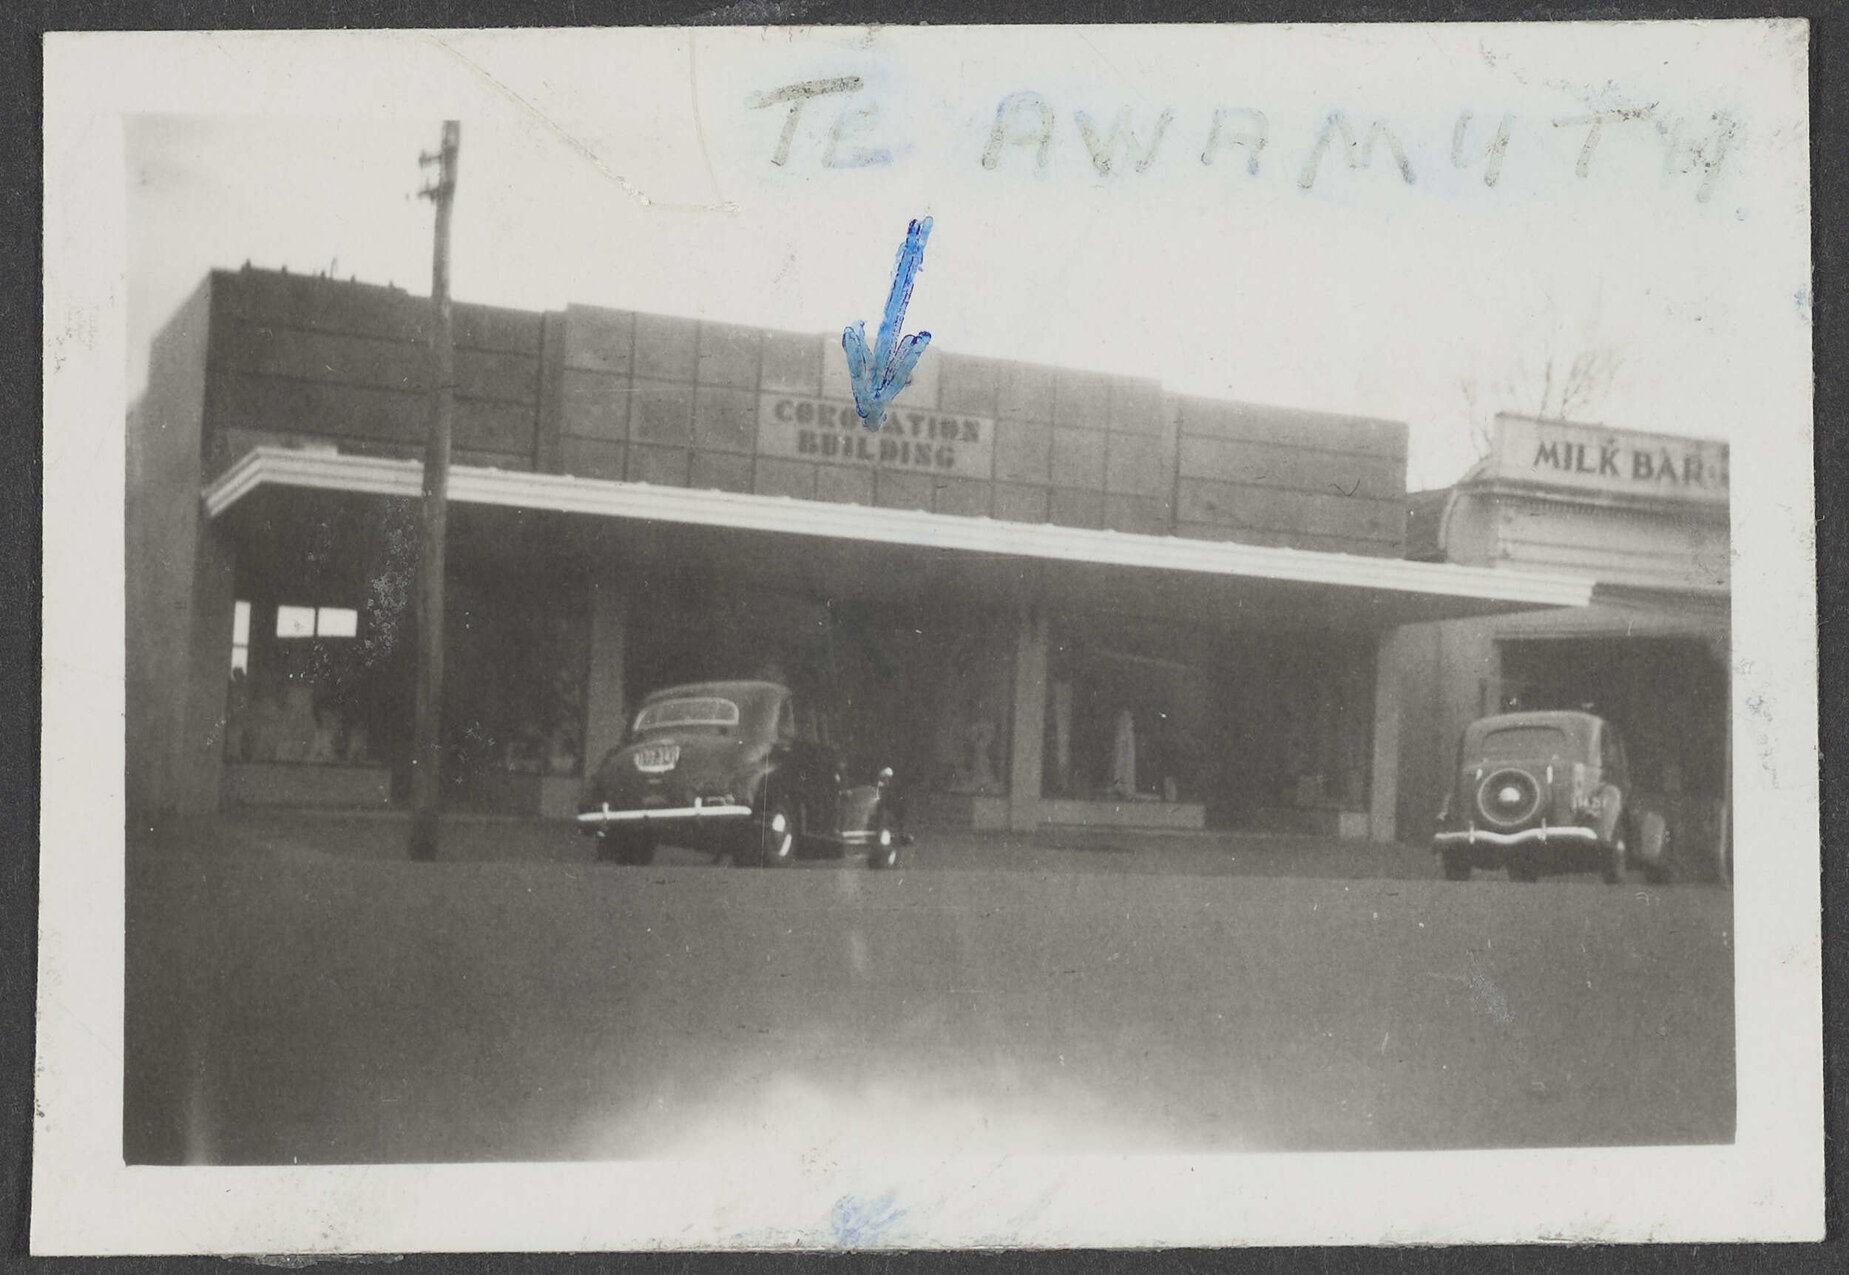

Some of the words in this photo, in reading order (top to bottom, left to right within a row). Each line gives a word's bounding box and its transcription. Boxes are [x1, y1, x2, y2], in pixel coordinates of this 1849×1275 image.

[746, 74, 890, 168] TE
[774, 400, 979, 442] COROATION
[799, 430, 955, 467] BUILDING
[1533, 440, 1621, 477] MILK
